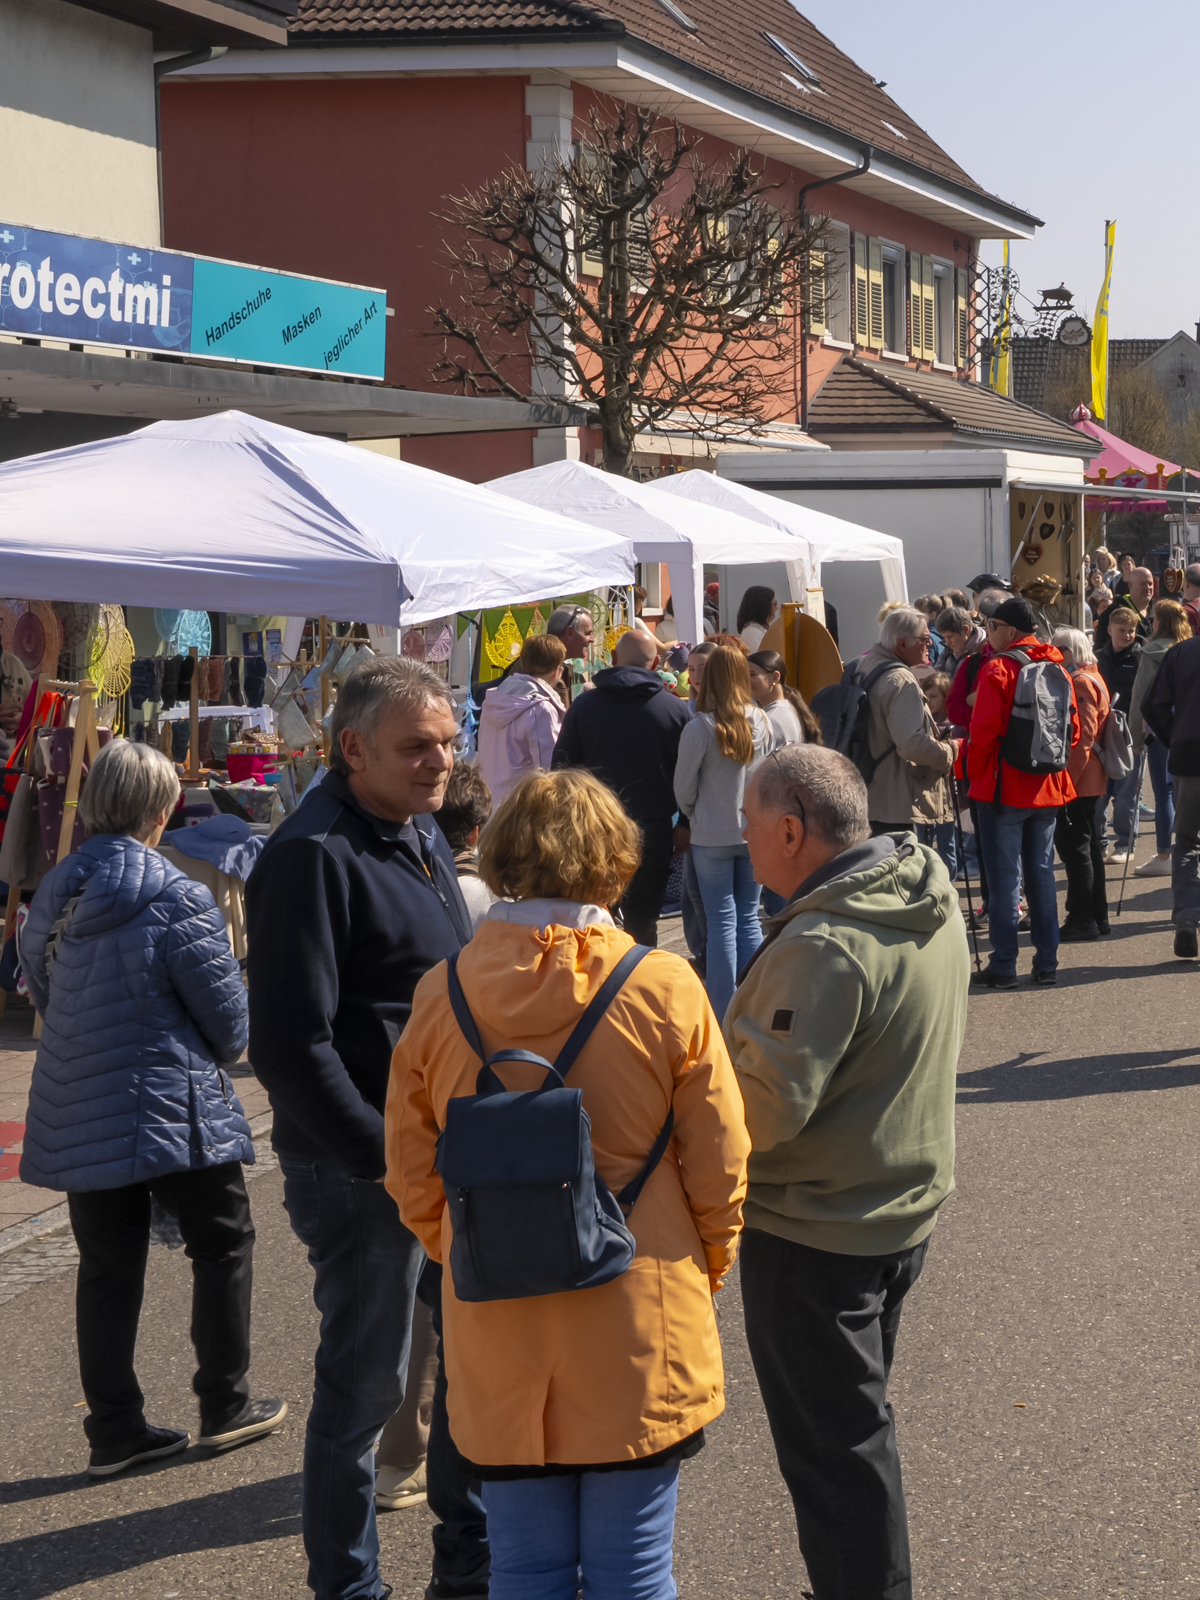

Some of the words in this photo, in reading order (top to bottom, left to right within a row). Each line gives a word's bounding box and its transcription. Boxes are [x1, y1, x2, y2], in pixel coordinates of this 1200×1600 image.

[205, 286, 273, 347] Handschuhe
[281, 304, 323, 346] Masken
[322, 317, 364, 370] jeglicher
[361, 300, 379, 331] Art
